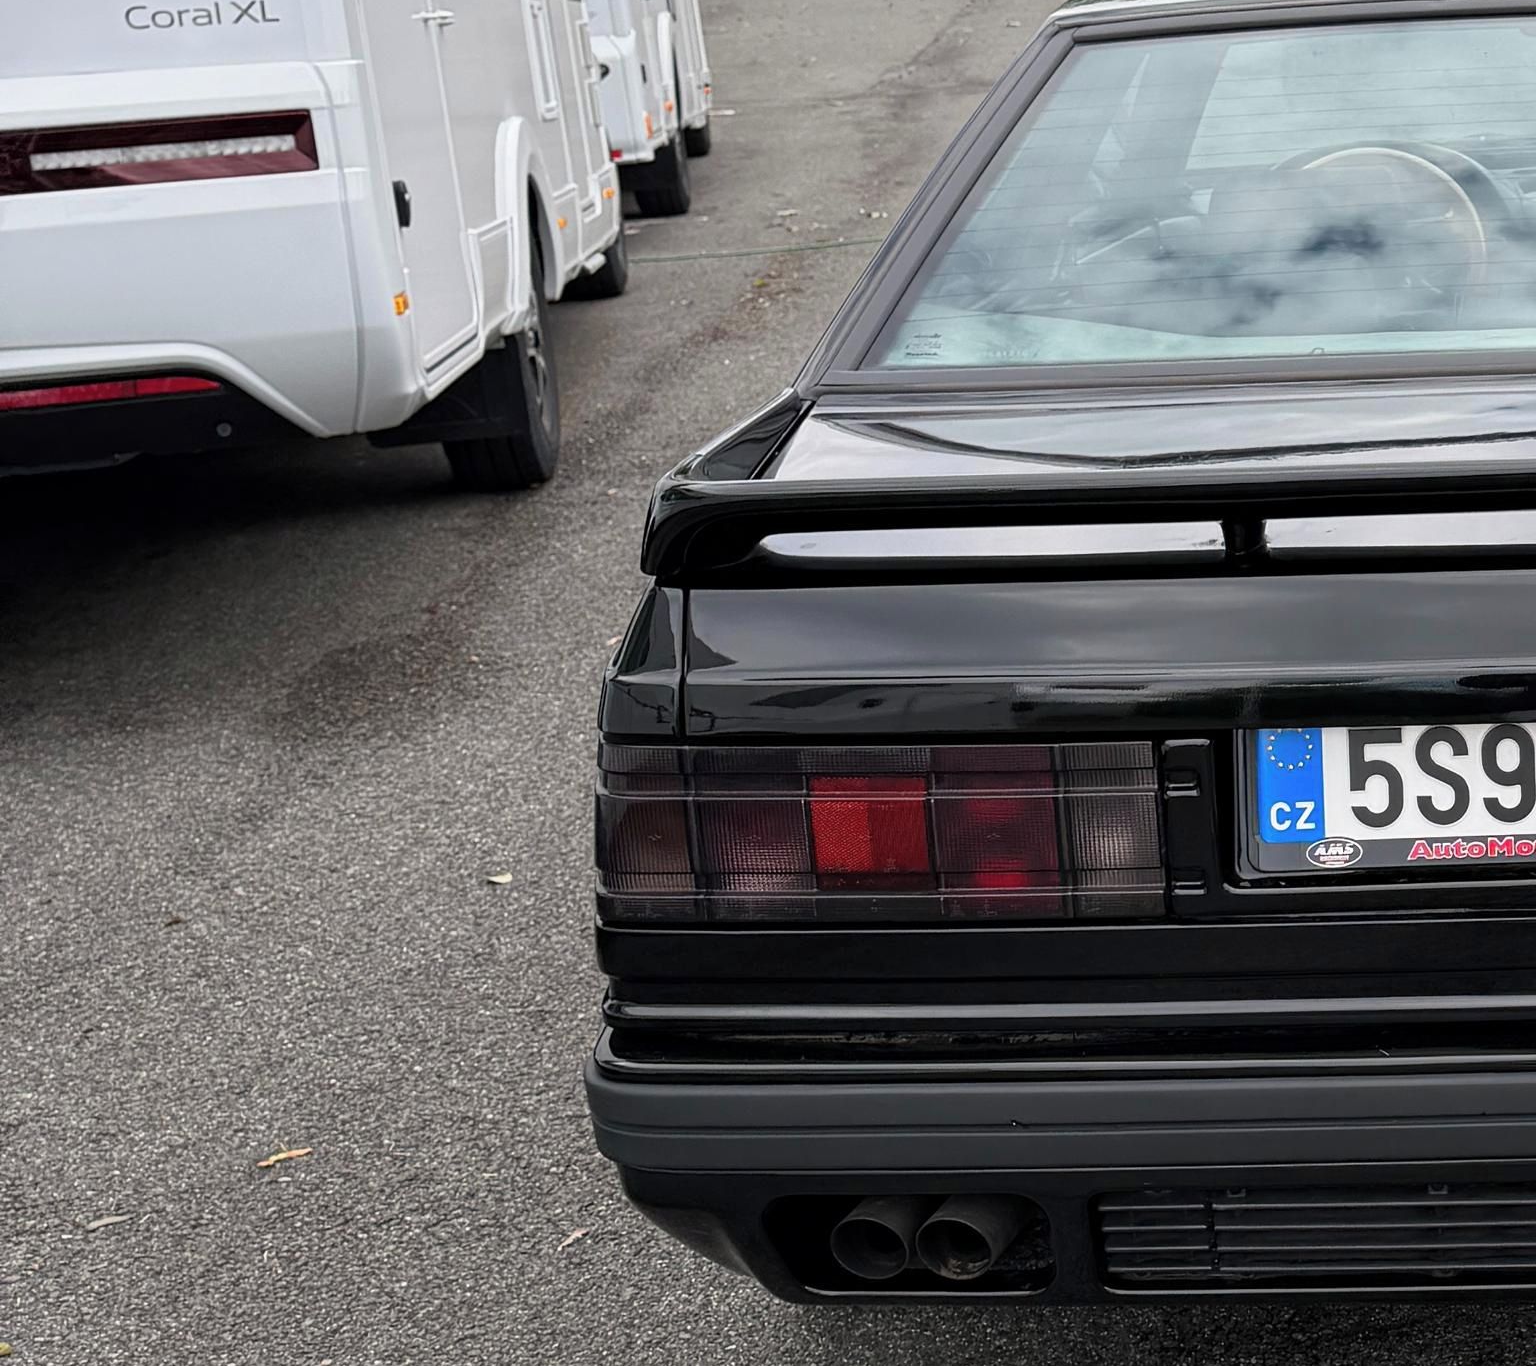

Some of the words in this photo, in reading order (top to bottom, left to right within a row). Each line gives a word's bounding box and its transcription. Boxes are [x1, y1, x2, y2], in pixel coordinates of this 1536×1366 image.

[124, 1, 222, 30] Coral
[230, 0, 280, 24] XL
[1269, 801, 1317, 832] CZ
[1314, 842, 1354, 856] AMS
